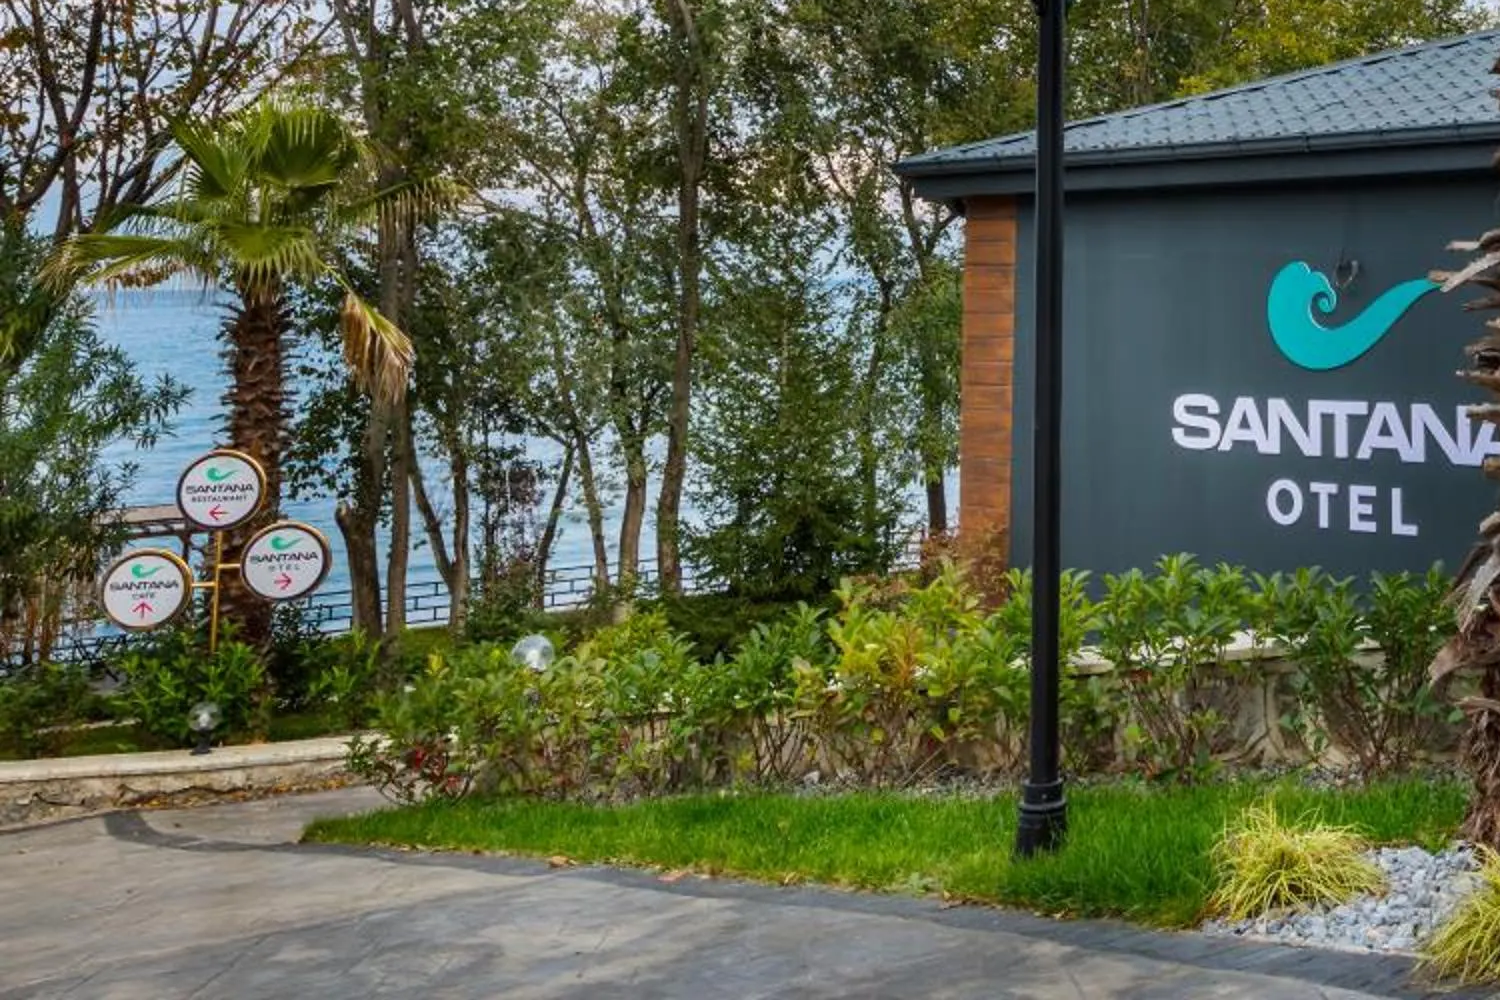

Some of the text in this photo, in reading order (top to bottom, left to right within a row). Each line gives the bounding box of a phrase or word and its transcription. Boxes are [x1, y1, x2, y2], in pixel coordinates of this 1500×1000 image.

[184, 483, 254, 494] SANTANA
[1266, 478, 1419, 536] OTEL
[250, 551, 319, 564] SANTANA
[109, 580, 179, 592] SANTANA
